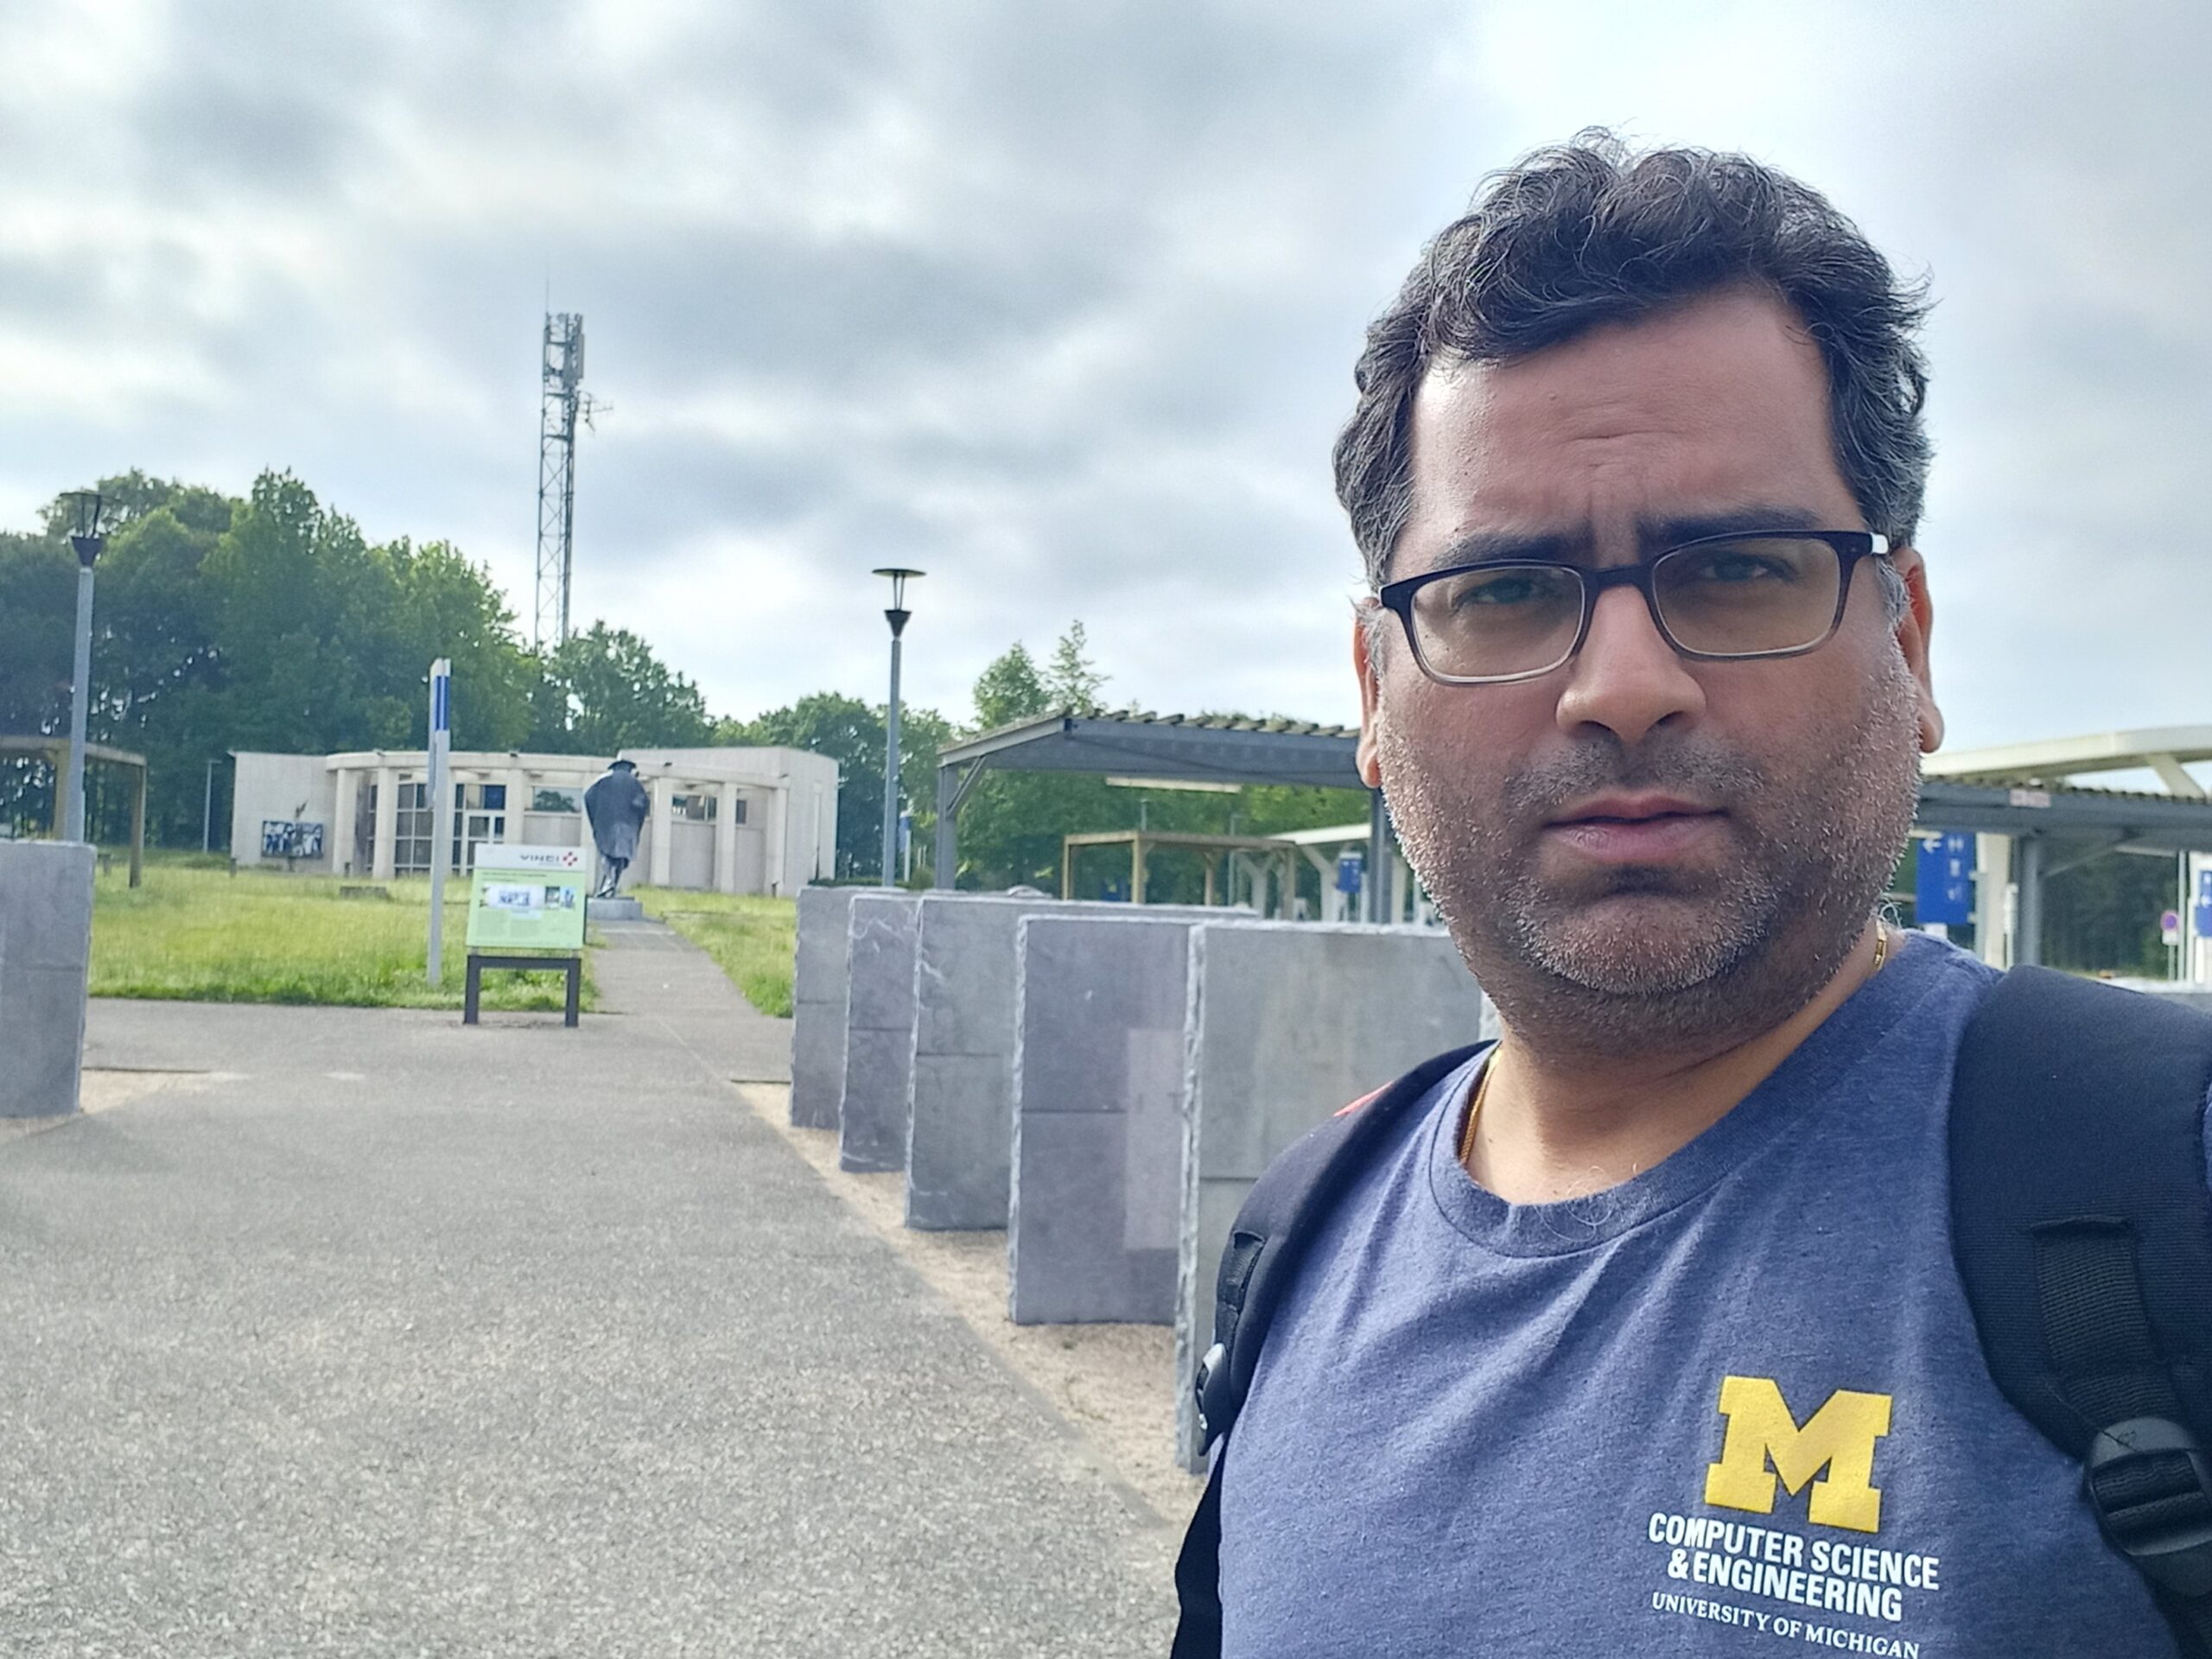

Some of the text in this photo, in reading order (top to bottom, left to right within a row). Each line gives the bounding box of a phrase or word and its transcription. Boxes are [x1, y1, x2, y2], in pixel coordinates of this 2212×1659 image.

[520, 854, 560, 862] VINCI
[1705, 1376, 1893, 1533] M
[1648, 1512, 1940, 1590] COMPUTER SCIENCE
[1668, 1548, 1903, 1622] & ENGINEERING
[1651, 1592, 1920, 1659] UNIVERSITY OF MICHIGAN
